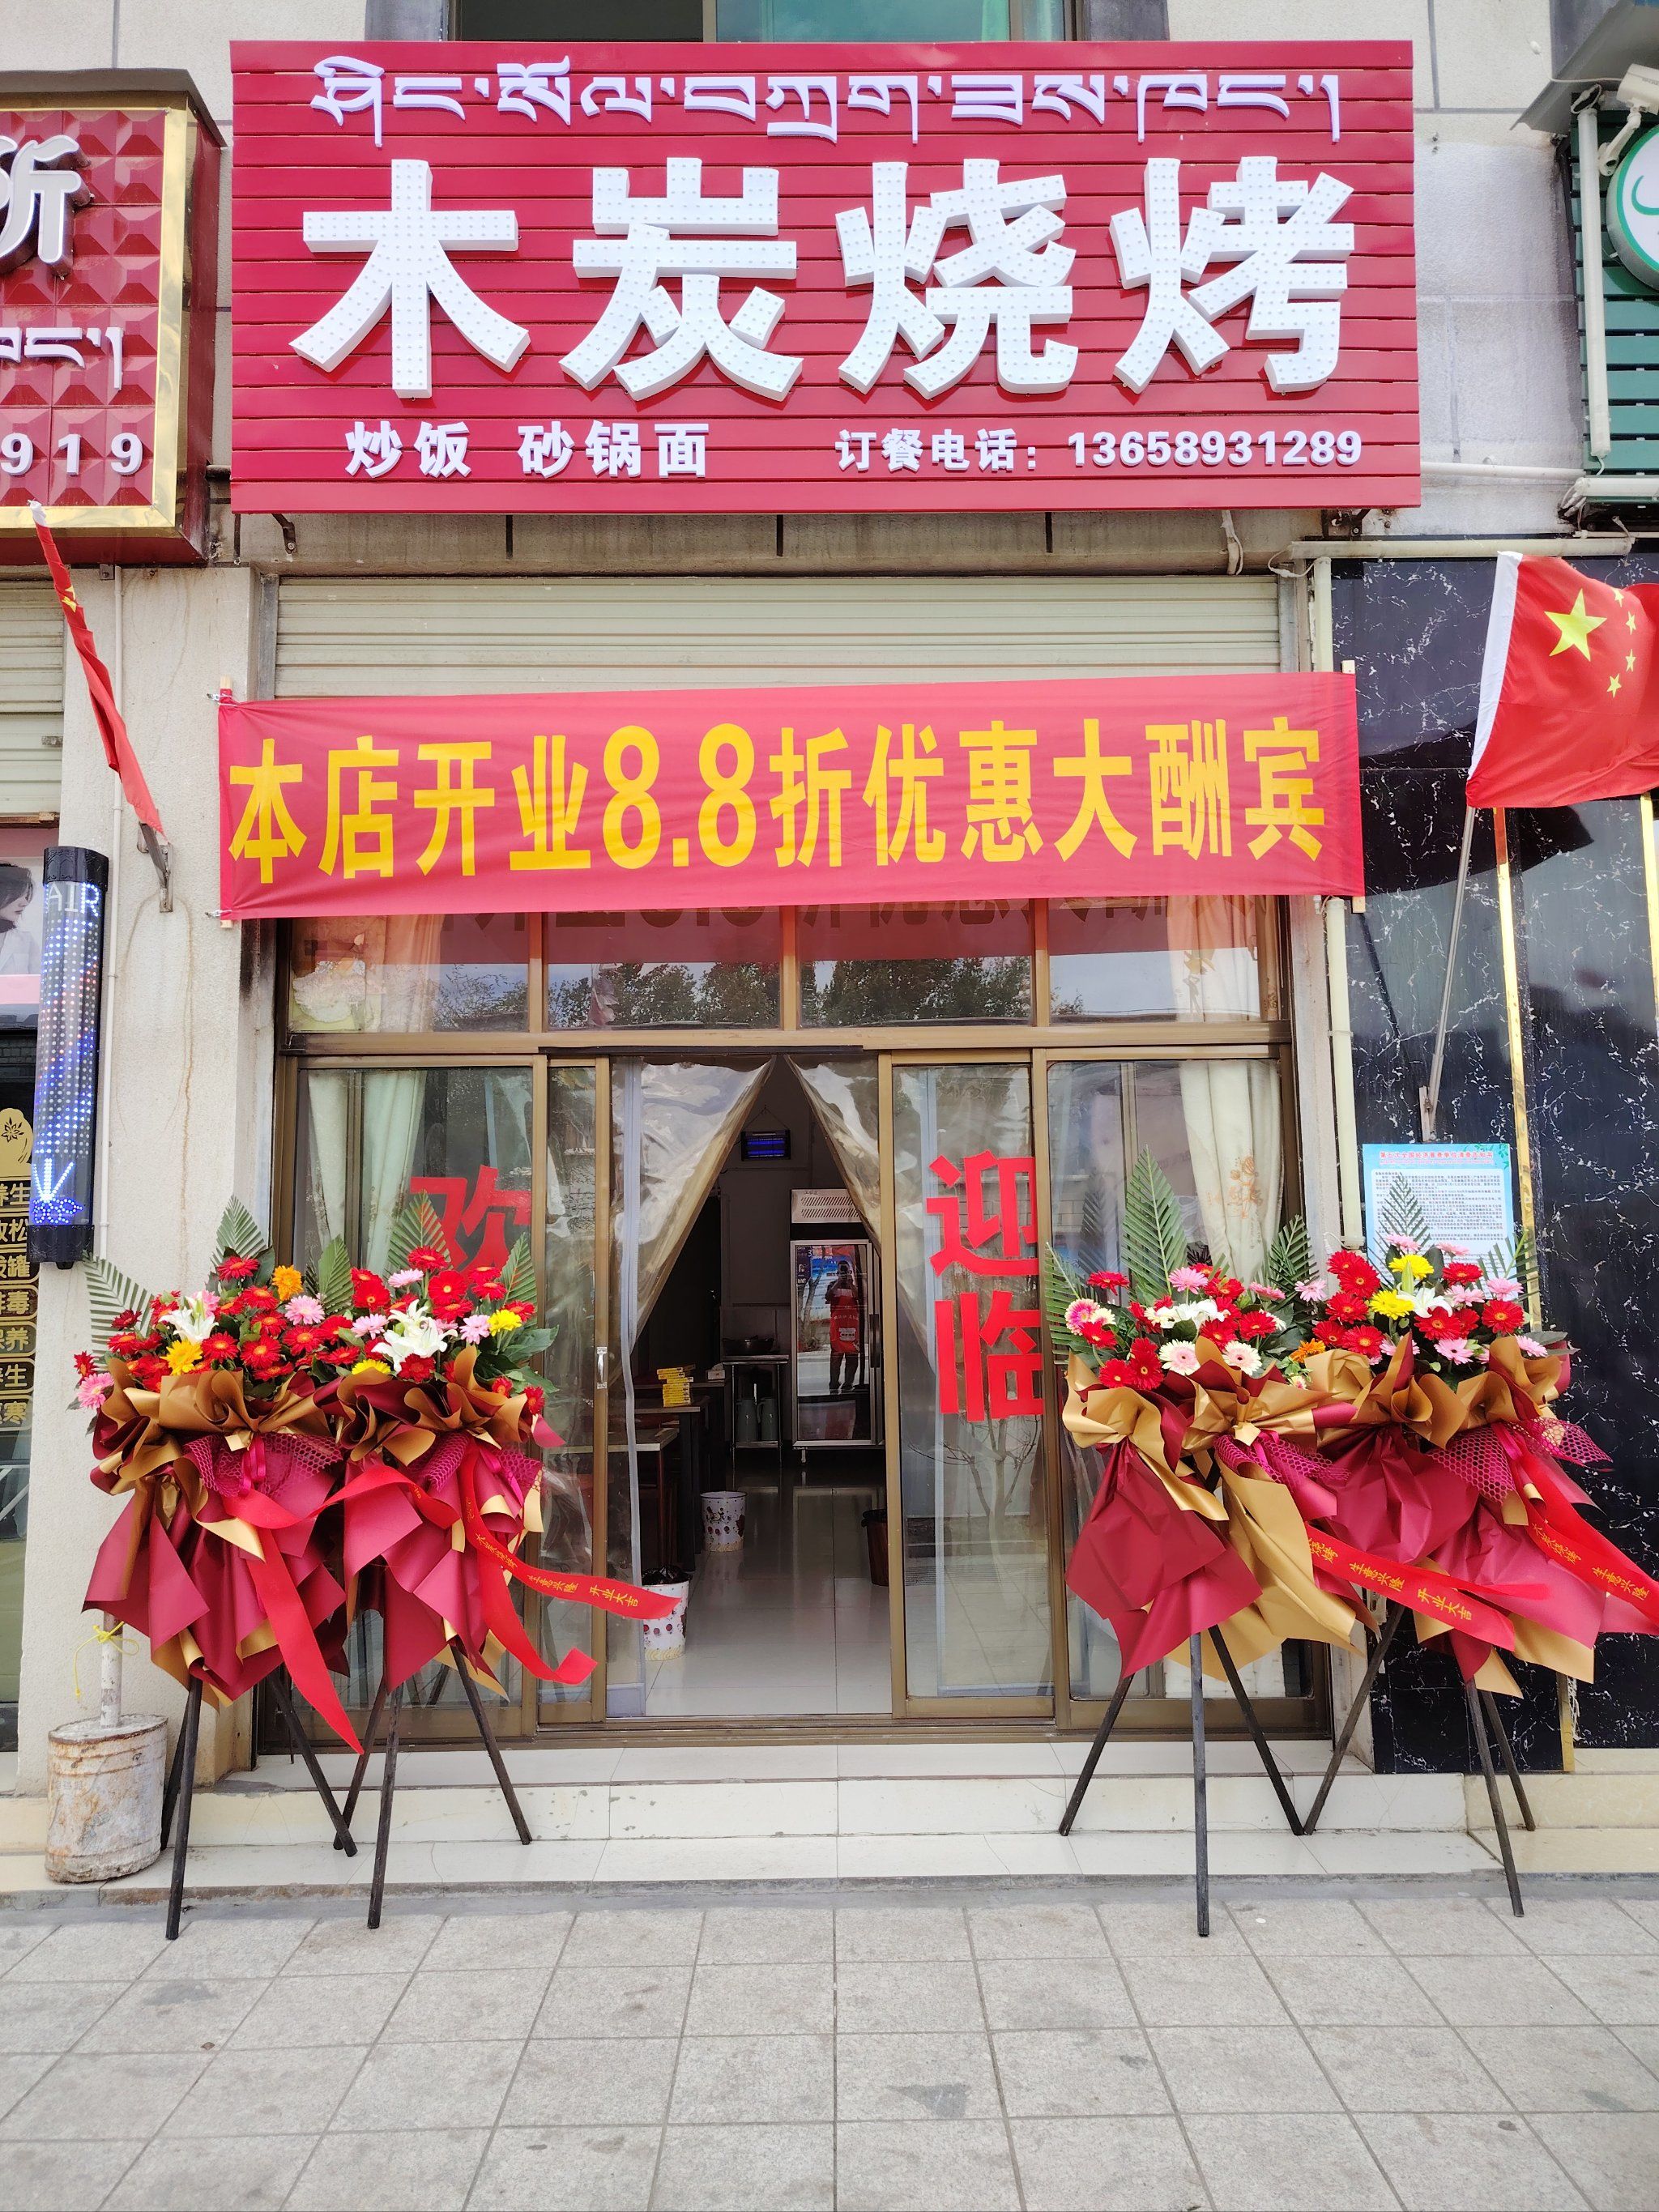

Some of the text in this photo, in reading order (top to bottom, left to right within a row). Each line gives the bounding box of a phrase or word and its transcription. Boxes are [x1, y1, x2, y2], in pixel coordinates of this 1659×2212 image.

[288, 156, 1355, 402] 木炭烧烤
[0, 432, 143, 475] 919
[345, 420, 472, 479] 炒饭
[517, 420, 710, 479] 砂锅面
[228, 716, 1326, 884] 本店开业8.8折优惠大酬宾
[926, 1150, 1039, 1277] 迎
[0, 1290, 30, 1315] 毒
[0, 1327, 30, 1352] 养
[935, 1291, 1044, 1422] 临
[0, 1363, 28, 1387] 生
[0, 1400, 28, 1426] 寒
[526, 1574, 580, 1594] 生意兴隆
[588, 1584, 640, 1608] 开业大吉
[1307, 1537, 1473, 1621] 烧烤 生意兴隆 开业大吉
[1591, 1566, 1650, 1600] 生意兴隆
